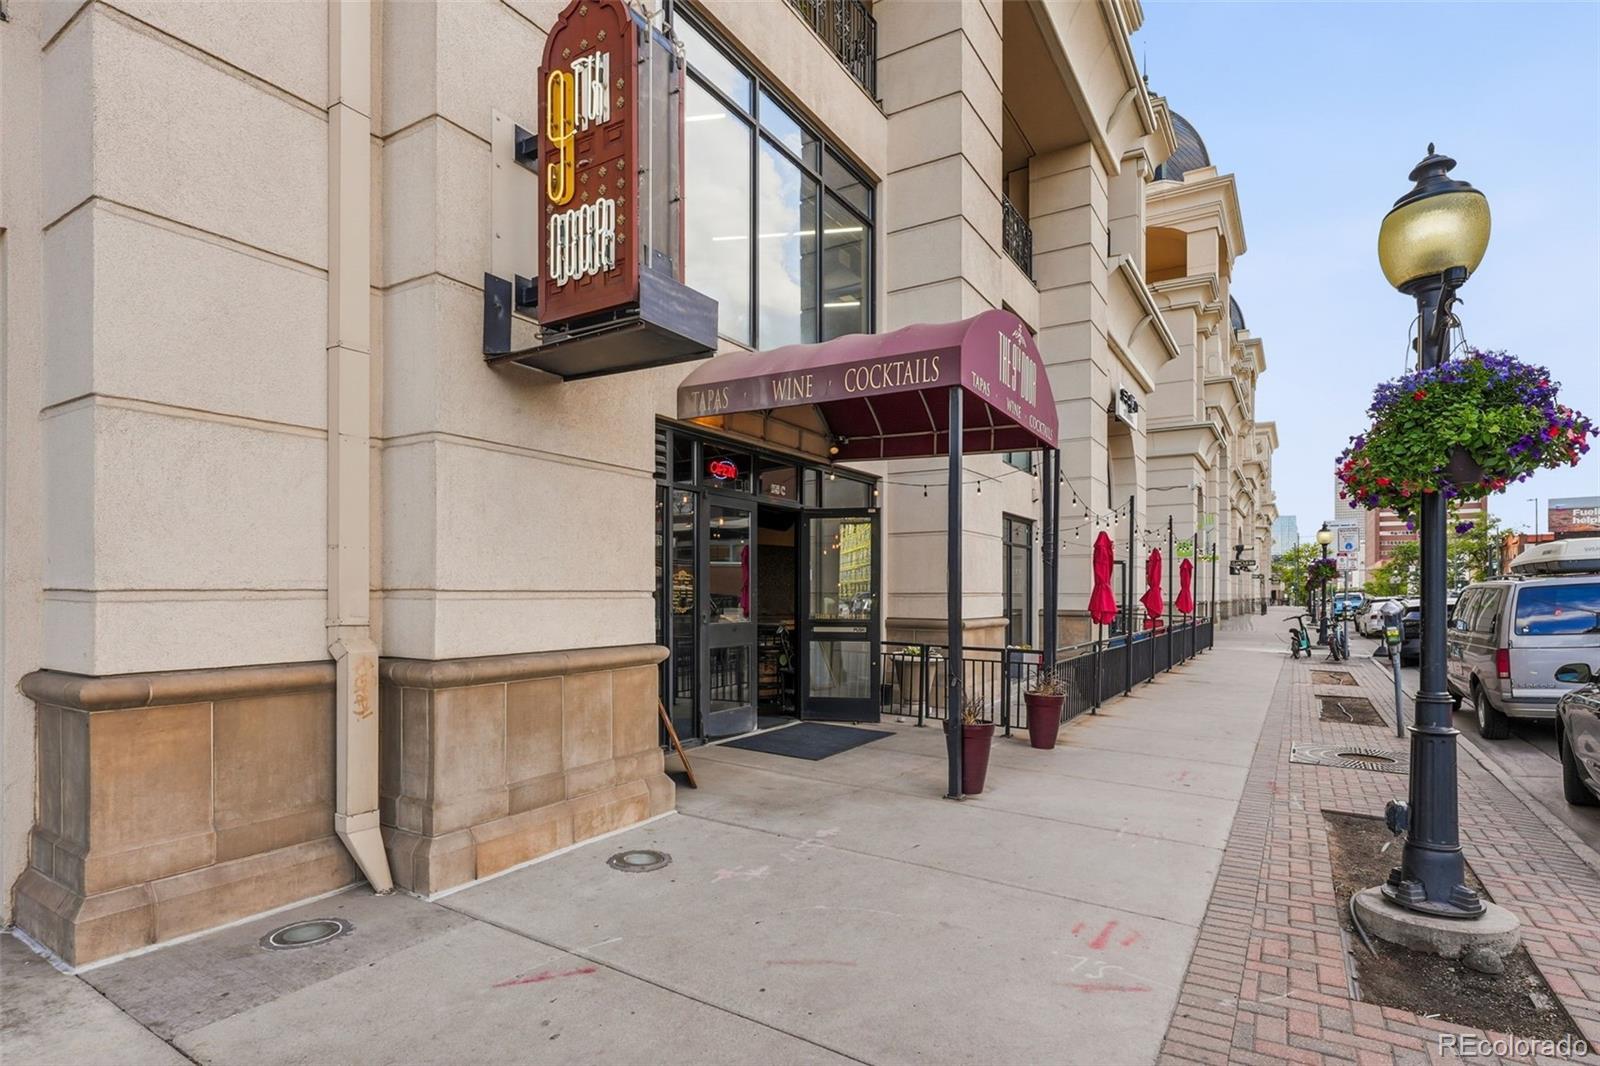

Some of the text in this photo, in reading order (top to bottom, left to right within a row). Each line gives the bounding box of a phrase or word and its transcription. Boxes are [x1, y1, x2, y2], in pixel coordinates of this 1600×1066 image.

[550, 198, 615, 286] DOOR
[691, 355, 940, 414] TAPAS WINE COCKTAILS
[971, 371, 991, 397] TAPAS
[1006, 397, 1022, 419] WINE
[998, 330, 1011, 388] THE
[1020, 351, 1037, 408] DOOR
[709, 461, 737, 479] OPEN
